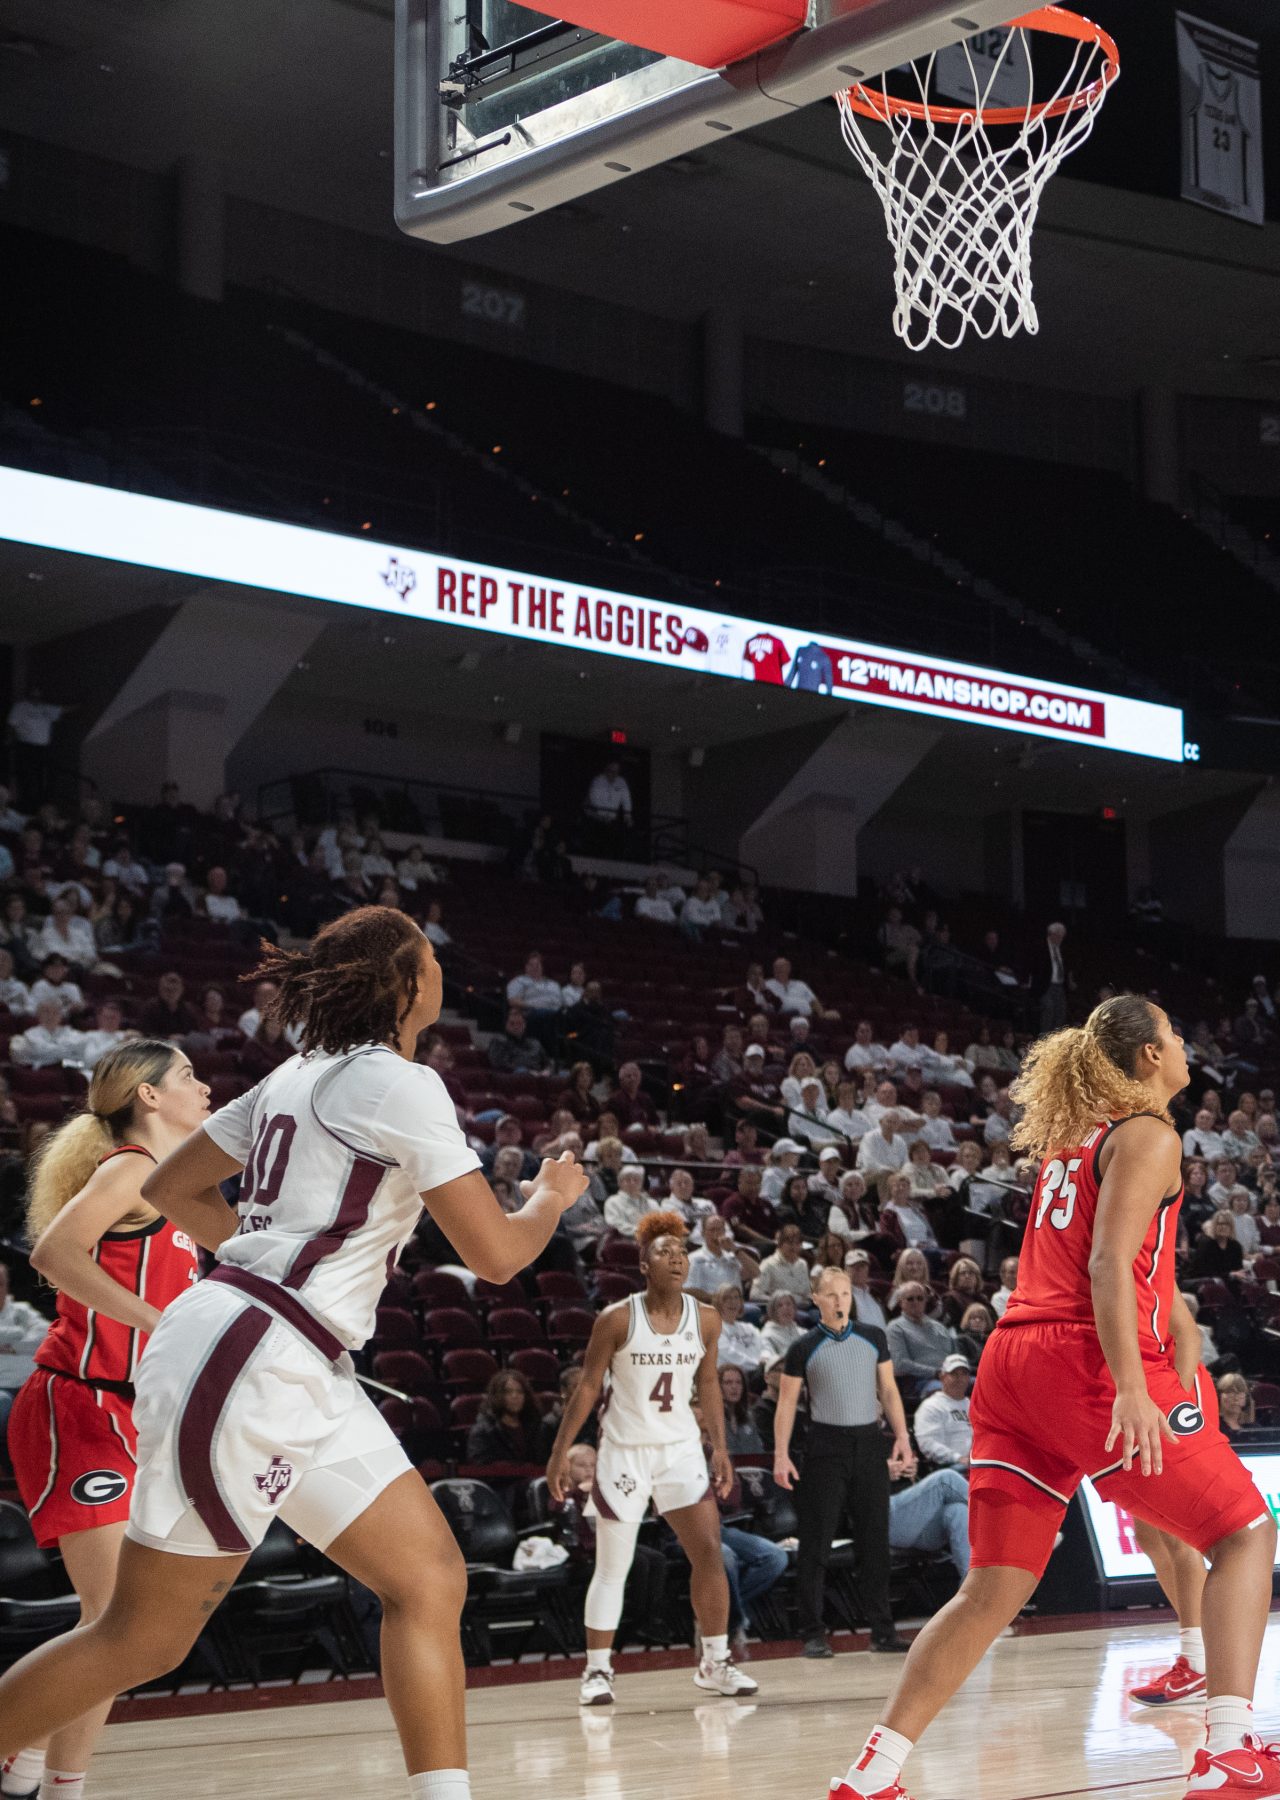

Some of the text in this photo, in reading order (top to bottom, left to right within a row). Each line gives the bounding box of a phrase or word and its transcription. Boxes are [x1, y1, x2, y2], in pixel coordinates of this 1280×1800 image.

[461, 285, 524, 323] 207
[904, 384, 966, 417] 208
[437, 567, 683, 656] REP THE AGGIES
[1035, 1159, 1083, 1230] 35
[631, 1353, 697, 1366] TEXAS A&M
[648, 1372, 674, 1412] 4
[1167, 1402, 1204, 1435] G
[71, 1470, 128, 1505] G
